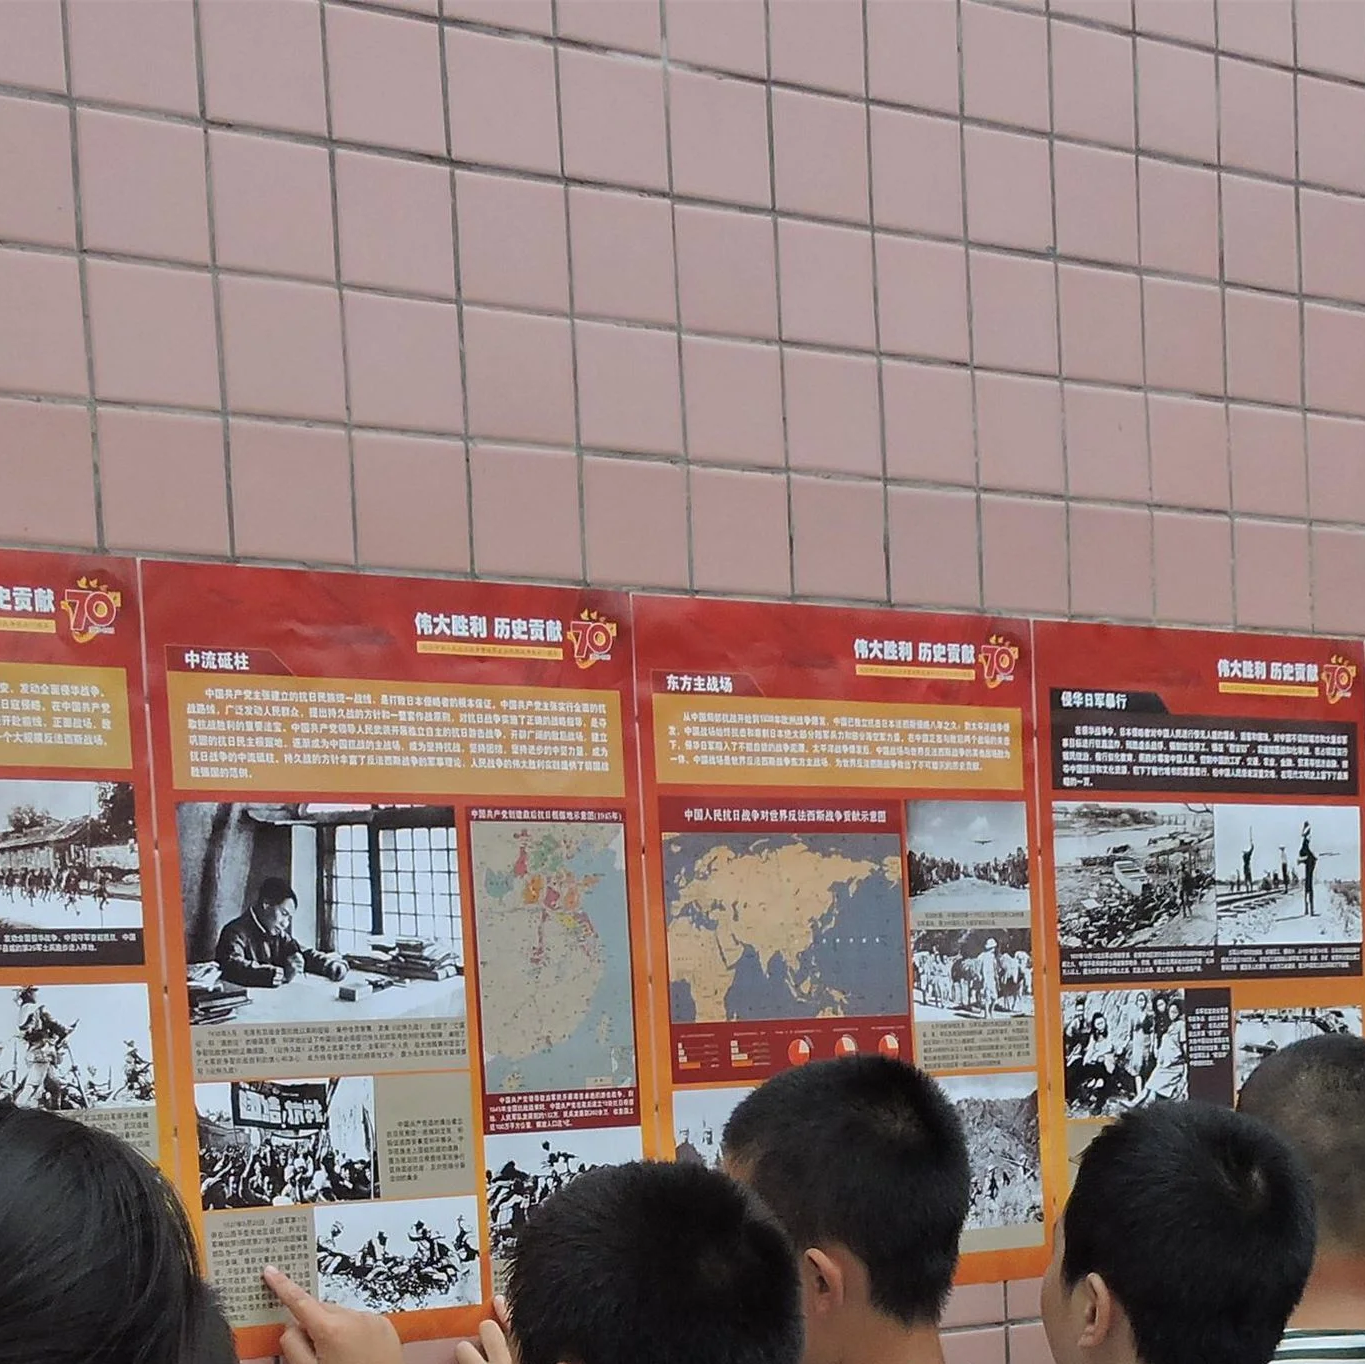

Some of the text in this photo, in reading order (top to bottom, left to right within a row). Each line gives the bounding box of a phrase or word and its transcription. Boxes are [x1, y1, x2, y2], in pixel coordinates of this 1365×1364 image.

[415, 612, 563, 643] 伟大胜利 历史贡献
[185, 650, 250, 671] 中流砥柱
[854, 638, 975, 665] 伟大胜利 历史贡献
[1217, 659, 1319, 682] 伟大胜利 历史贡献
[666, 673, 733, 693] 东方主战场
